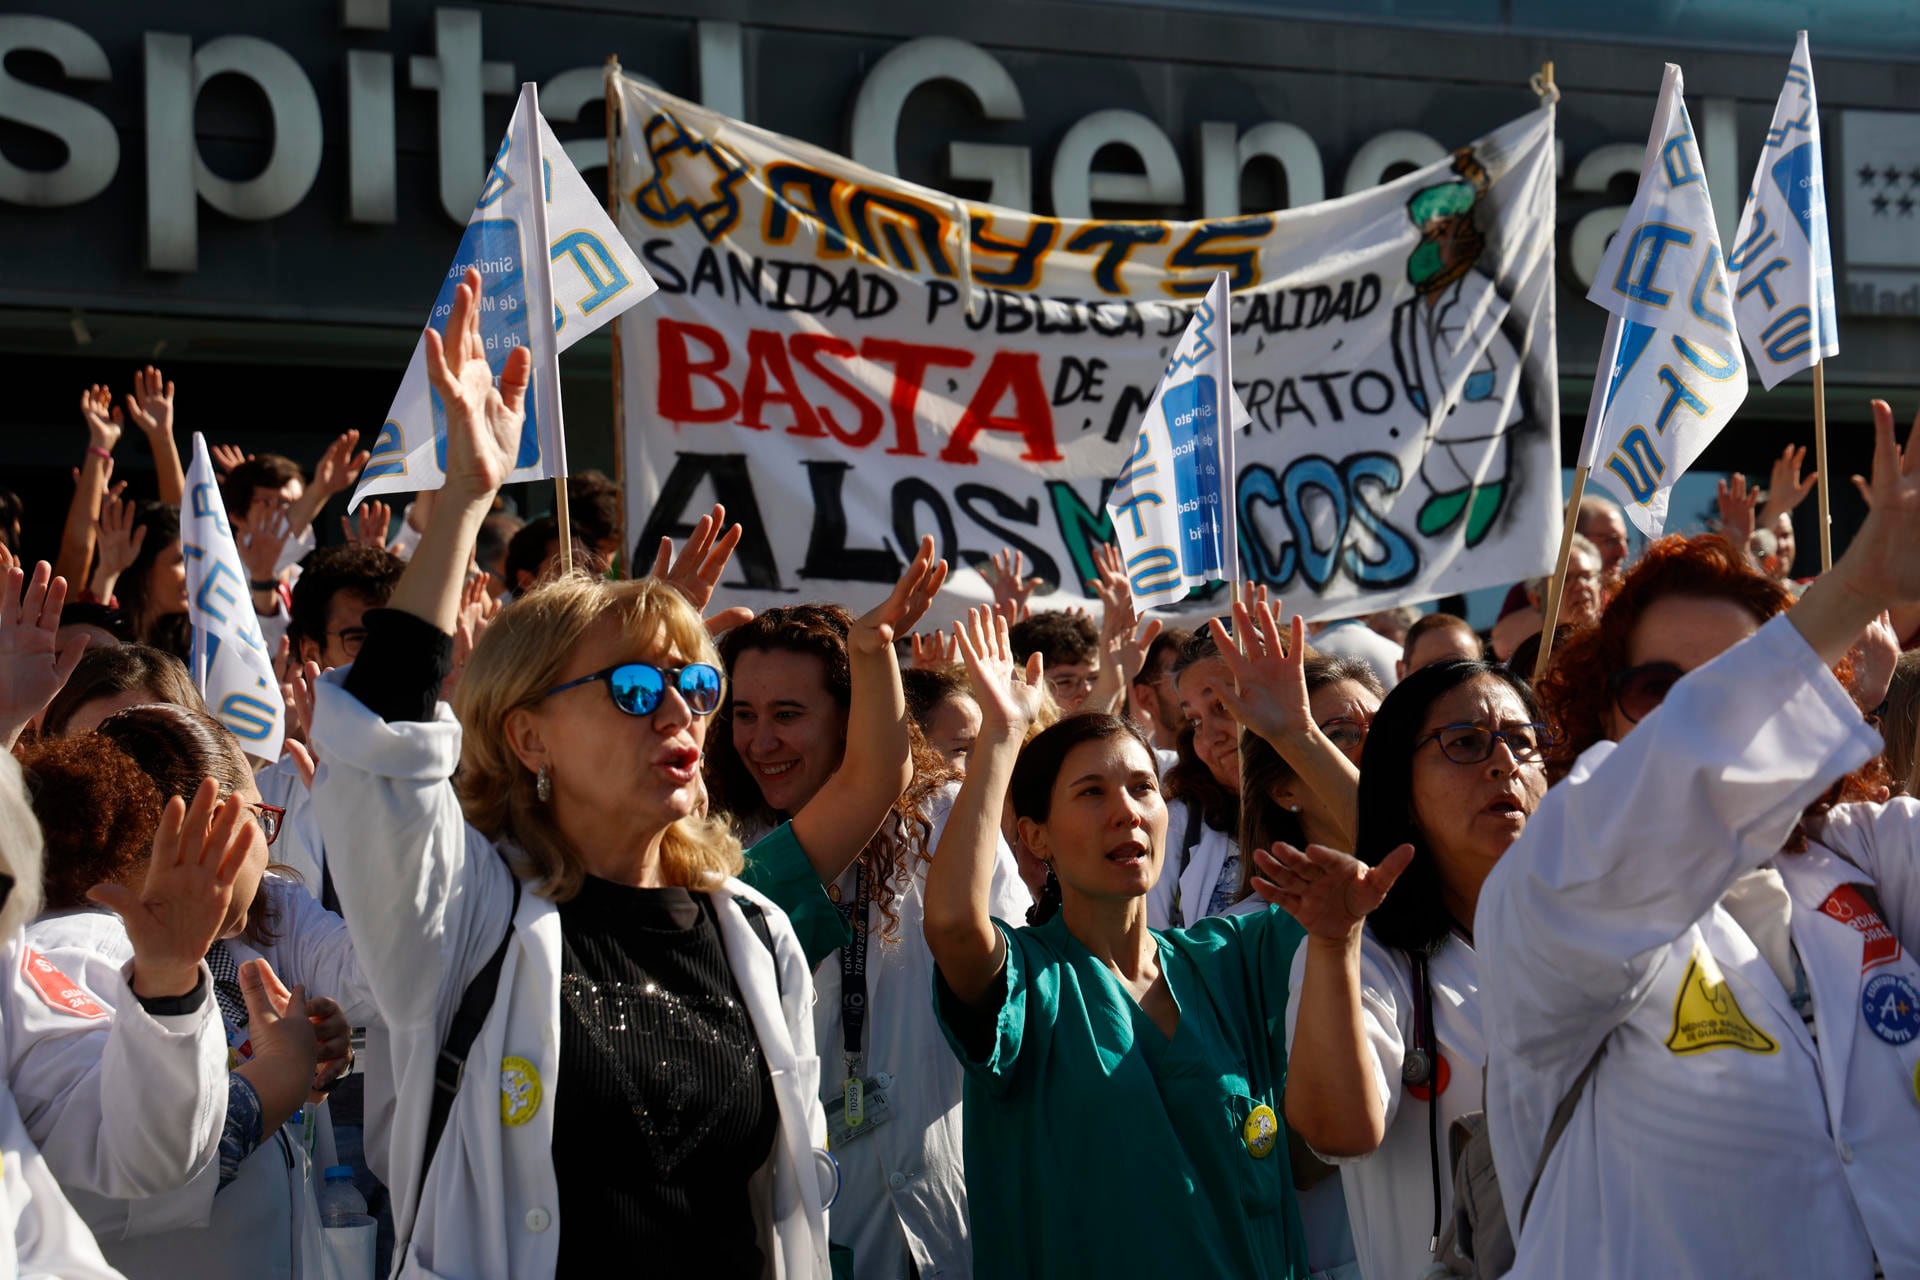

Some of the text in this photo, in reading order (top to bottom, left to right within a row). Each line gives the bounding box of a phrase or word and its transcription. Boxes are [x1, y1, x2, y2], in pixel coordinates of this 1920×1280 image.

[637, 238, 898, 319] SANIDAD
[924, 280, 1144, 339] PUBLICA
[656, 317, 1065, 466] BASTA
[1051, 356, 1110, 408] DE
[630, 450, 798, 593] A
[1044, 451, 1420, 598] MCOS
